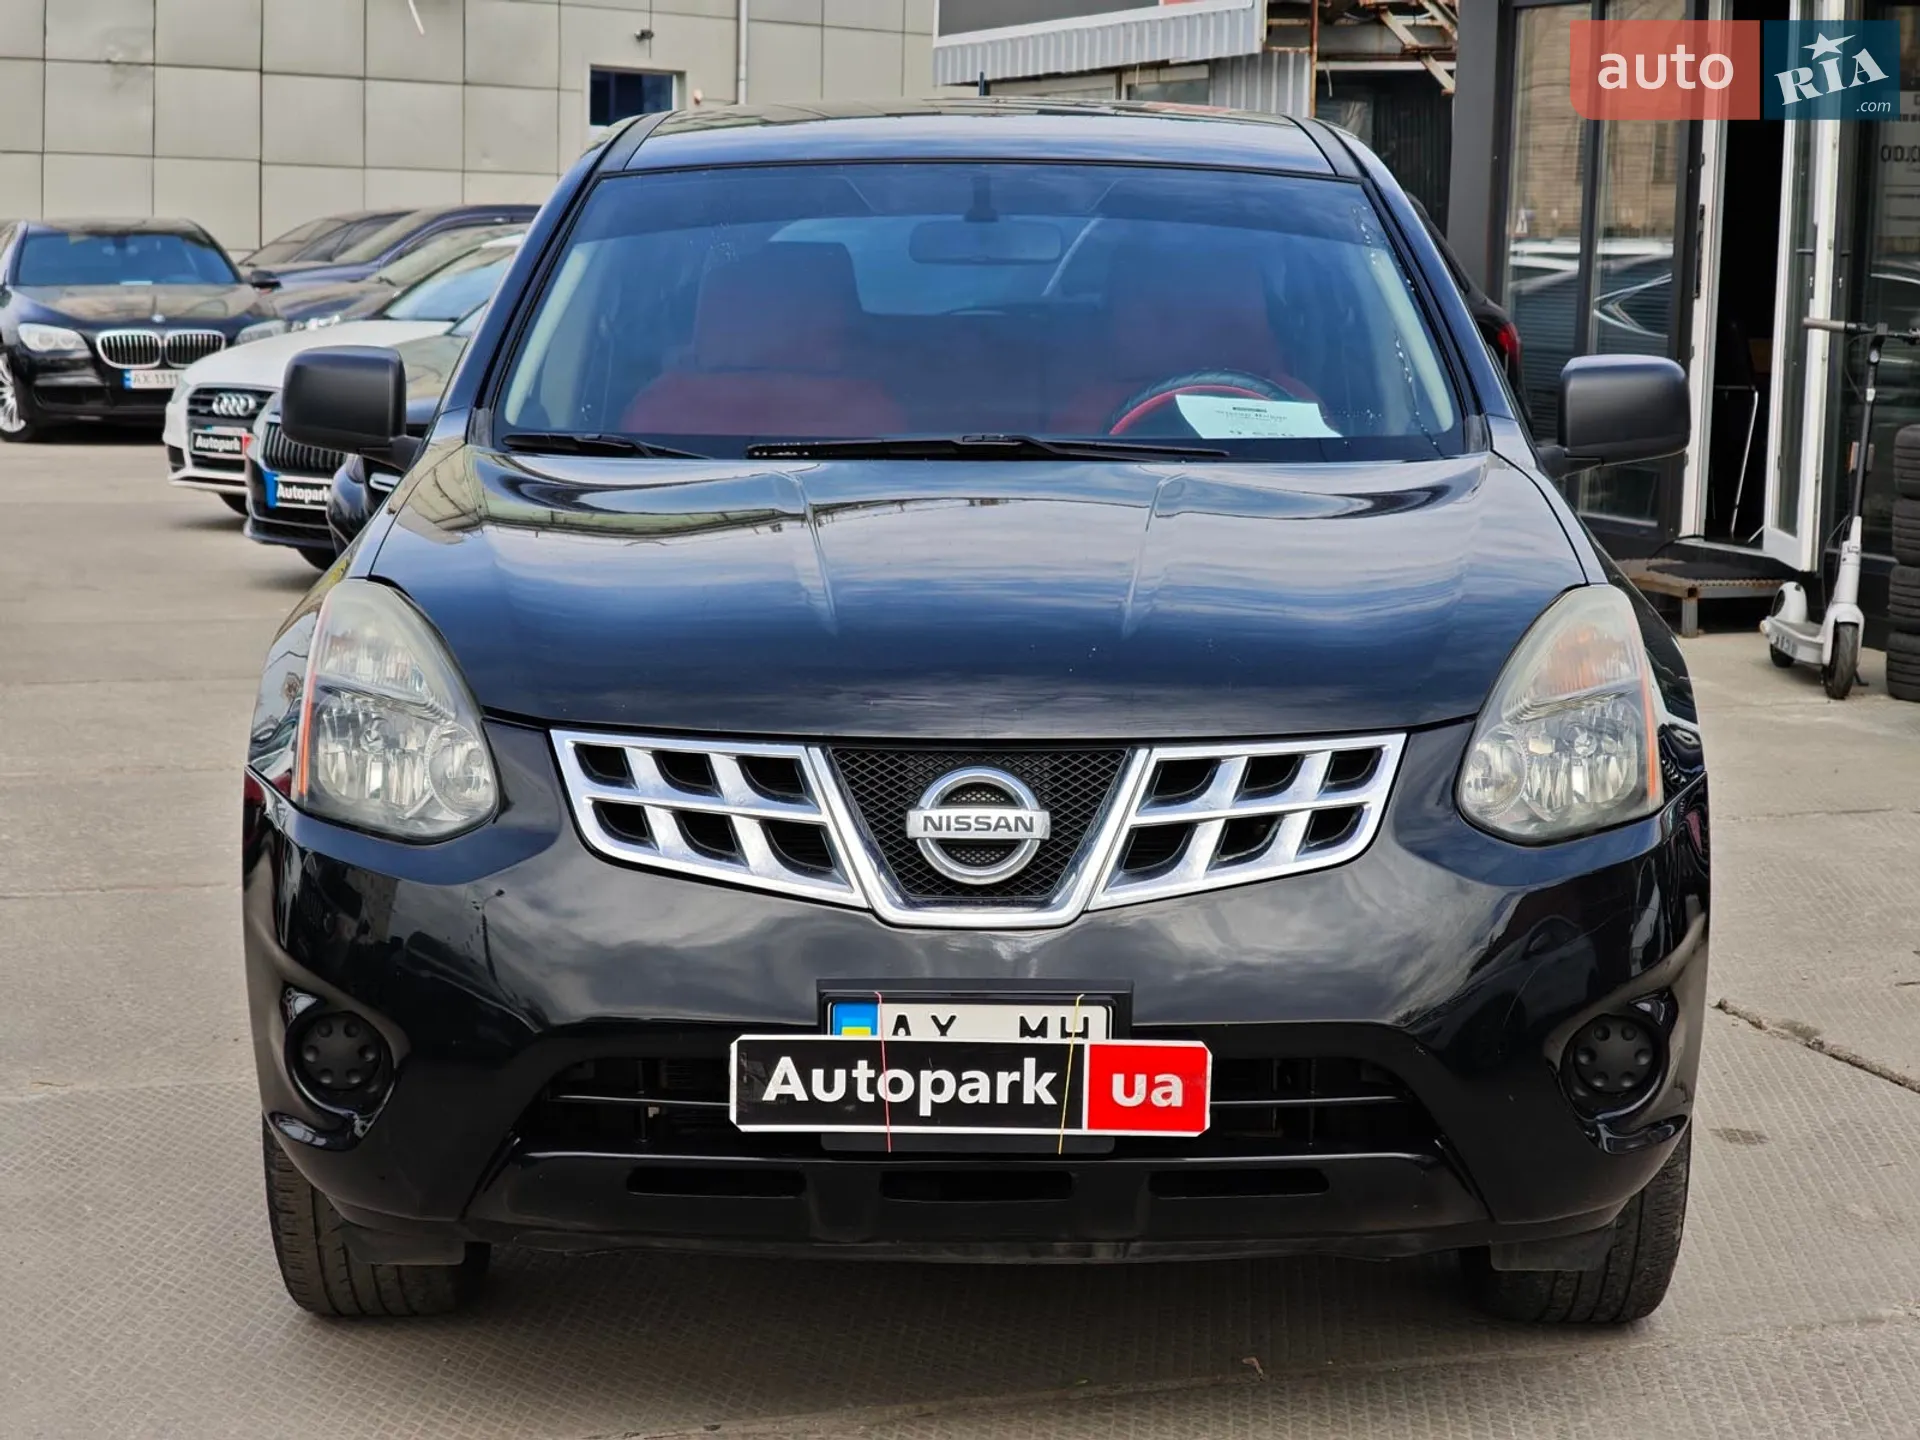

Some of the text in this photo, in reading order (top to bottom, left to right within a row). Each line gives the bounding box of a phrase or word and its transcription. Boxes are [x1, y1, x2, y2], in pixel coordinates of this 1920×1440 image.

[195, 434, 242, 452] Autopark
[922, 815, 1034, 833] NISSAN
[762, 1056, 1184, 1116] Autopark ua
